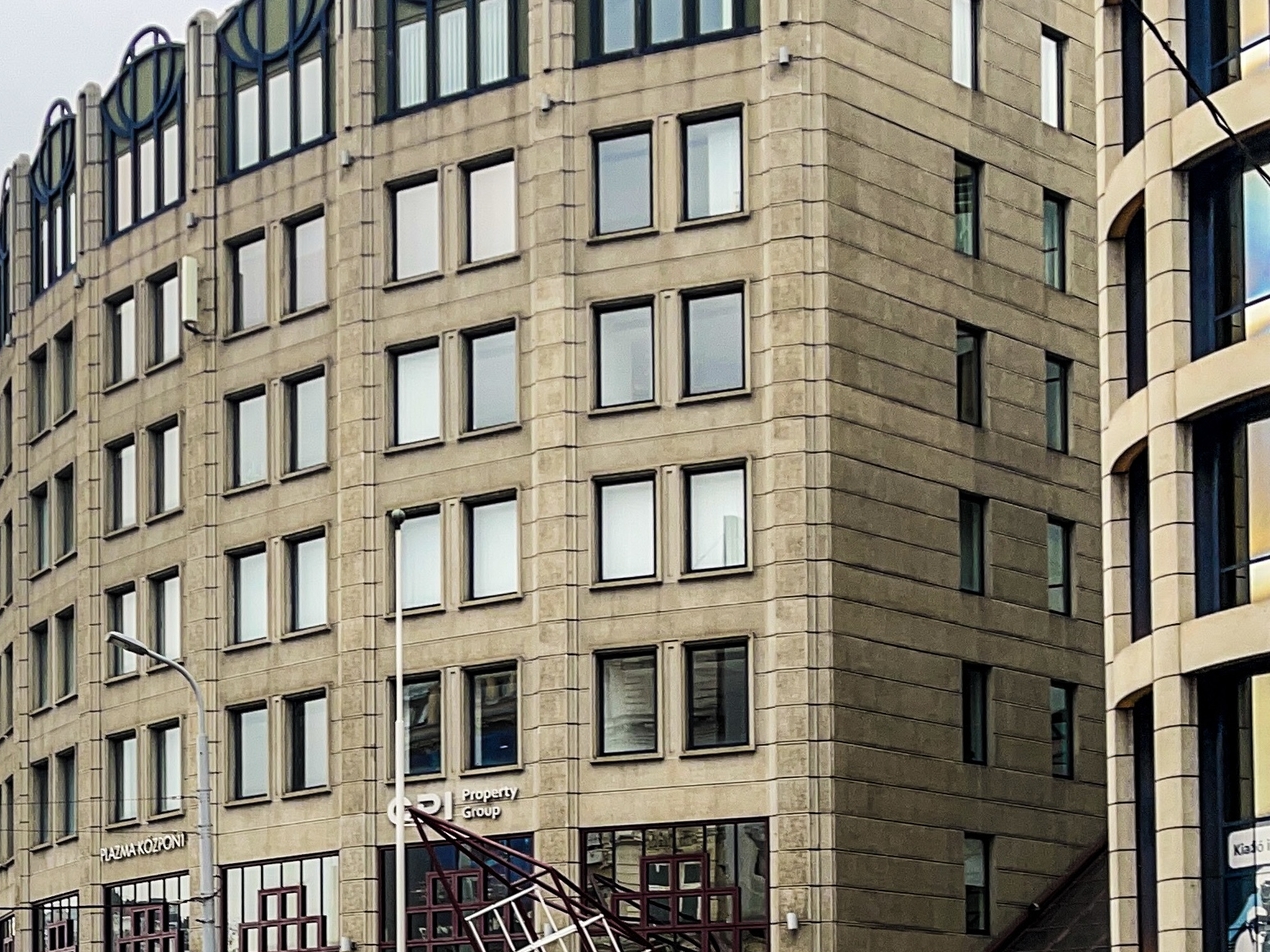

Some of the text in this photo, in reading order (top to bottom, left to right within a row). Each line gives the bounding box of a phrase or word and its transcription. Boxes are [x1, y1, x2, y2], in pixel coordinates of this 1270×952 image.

[462, 786, 518, 802] Property
[462, 806, 501, 819] Group
[100, 842, 136, 862] PLAZMA
